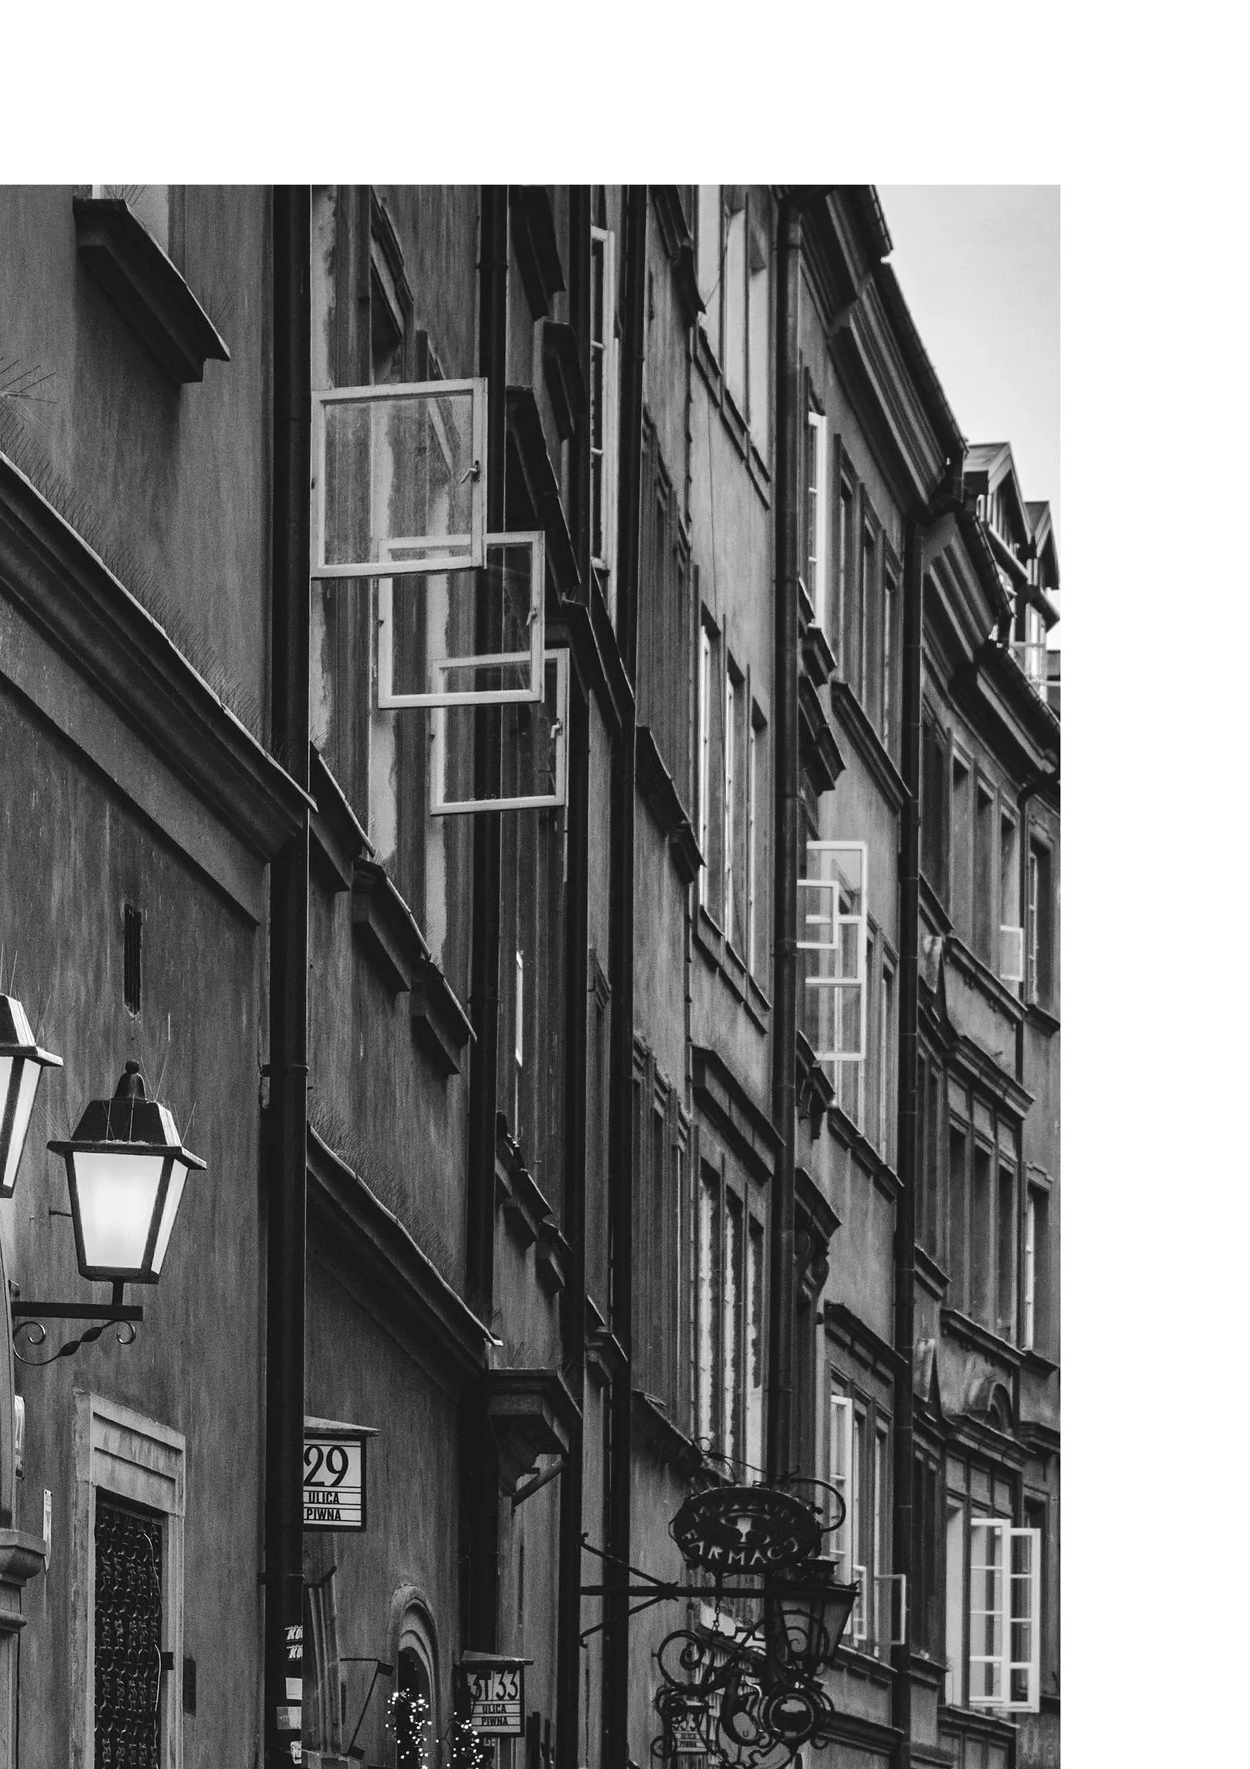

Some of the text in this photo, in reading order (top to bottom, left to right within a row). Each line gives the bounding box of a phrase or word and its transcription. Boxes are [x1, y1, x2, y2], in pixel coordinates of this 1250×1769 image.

[304, 1445, 349, 1487] 29
[309, 1491, 340, 1504] ULICA
[306, 1508, 342, 1521] PIWNA
[496, 1670, 519, 1701] 33
[482, 1704, 507, 1713] ULICA
[481, 1717, 508, 1726] PIWNA
